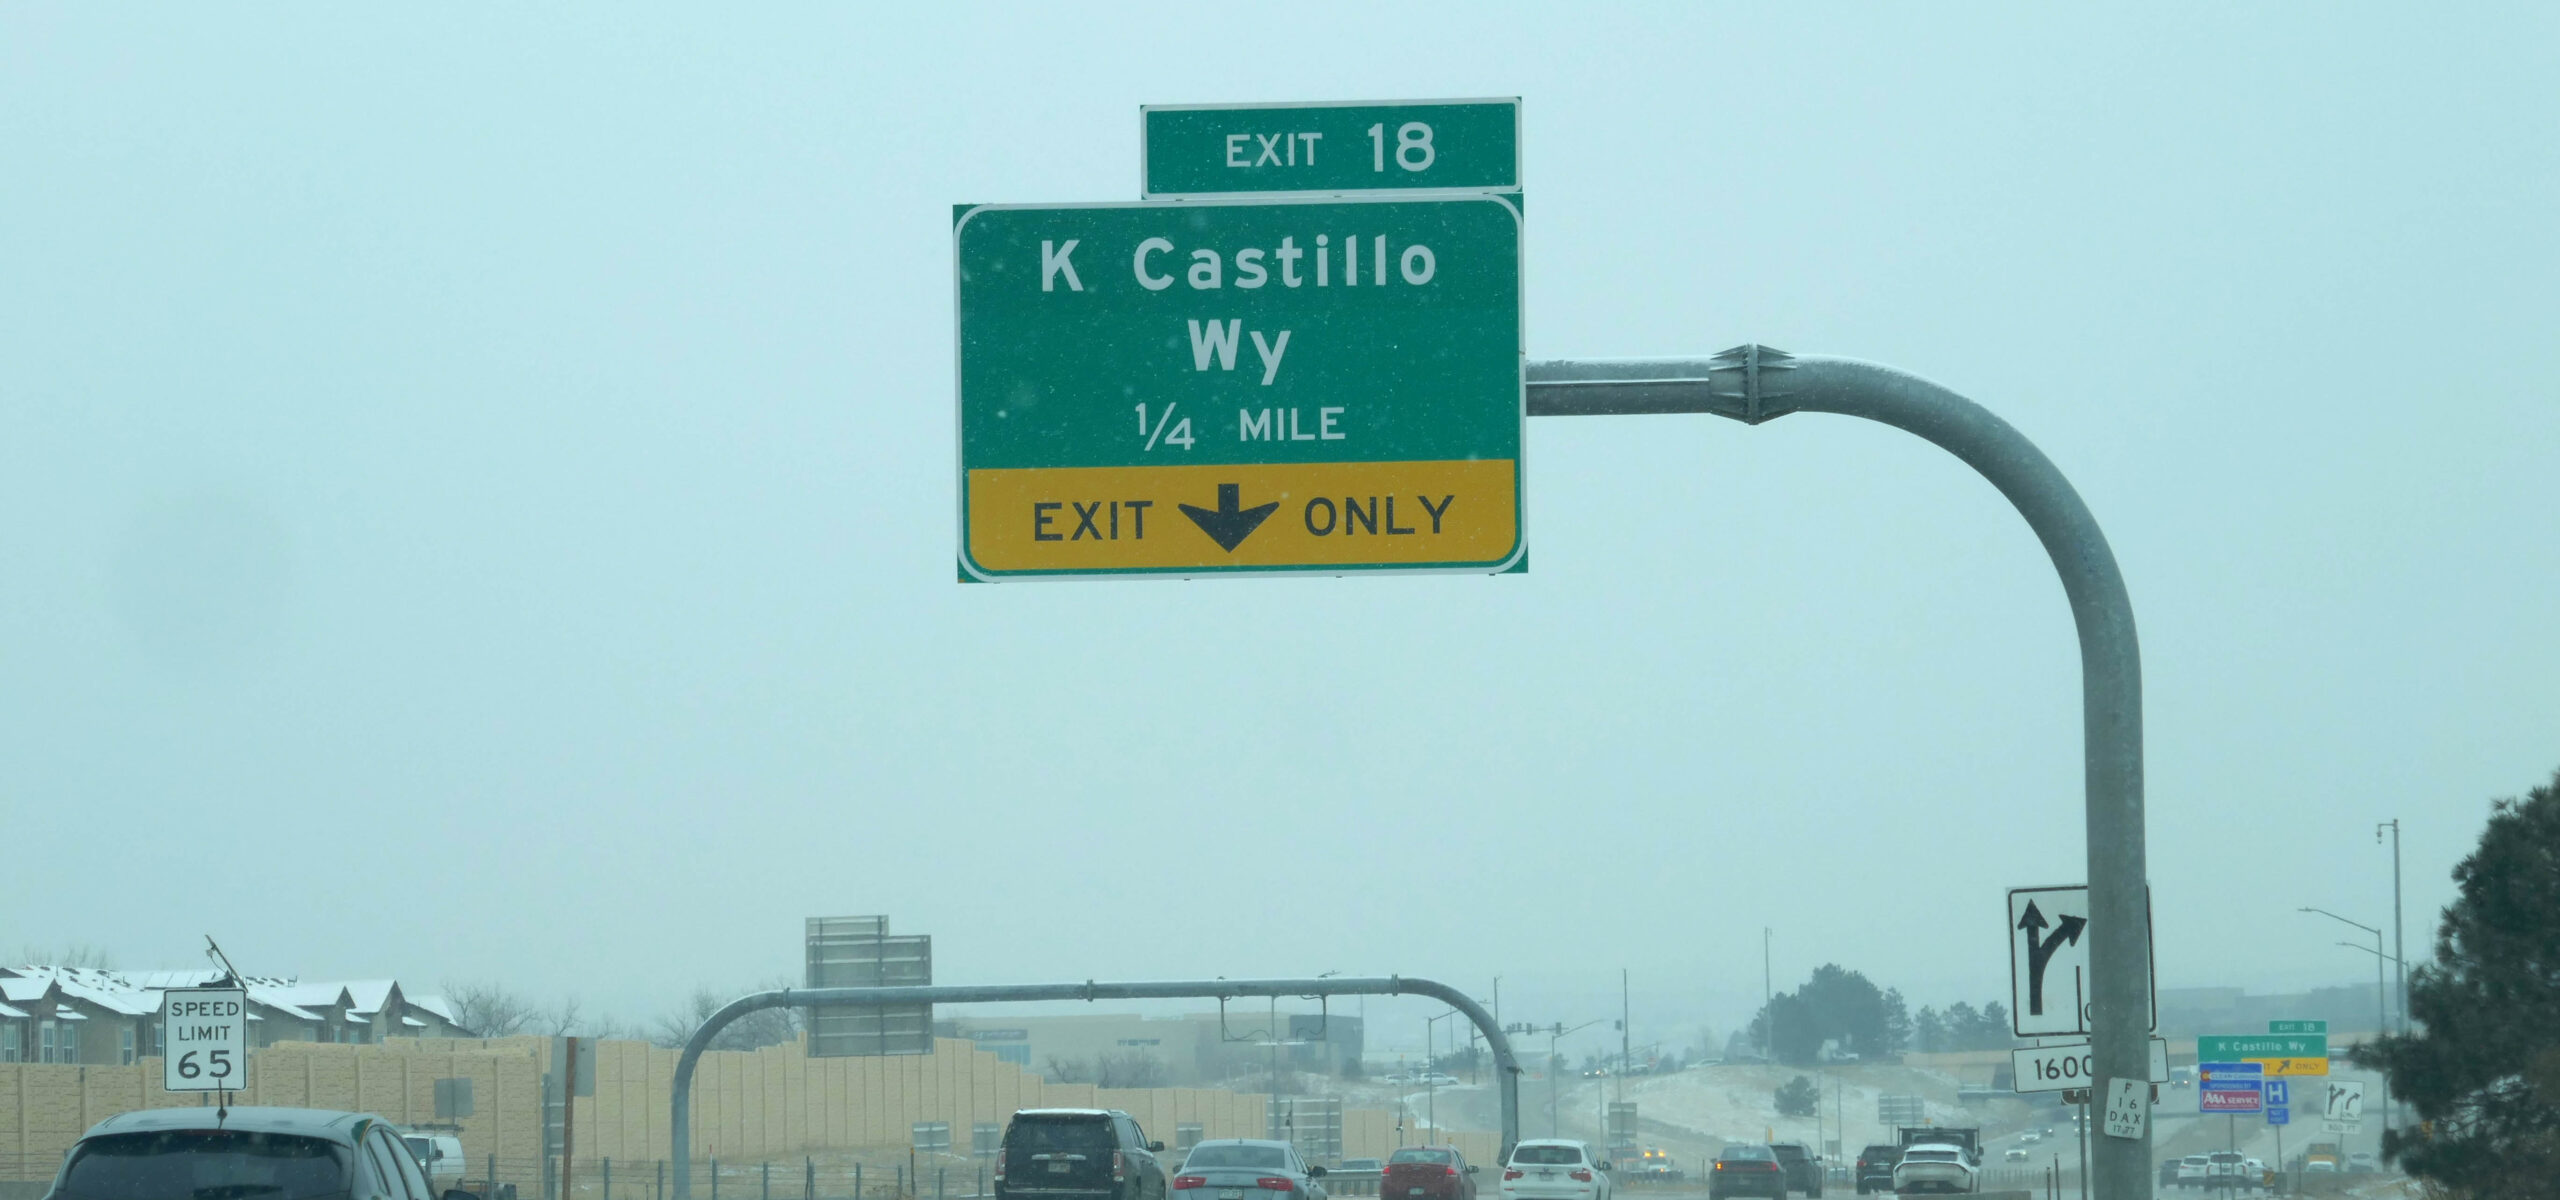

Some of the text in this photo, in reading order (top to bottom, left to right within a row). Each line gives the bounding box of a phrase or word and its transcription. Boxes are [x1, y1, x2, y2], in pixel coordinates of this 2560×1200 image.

[1226, 122, 1435, 172] EXIT 18
[1041, 234, 1437, 292] K Castillo
[1187, 319, 1291, 386] Wy
[1239, 407, 1345, 441] MILE
[1033, 494, 1455, 541] EXIT ONLY
[171, 1002, 239, 1016] SPEED
[179, 1026, 230, 1041] LIMIT
[2279, 1023, 2315, 1032] EXIT 18
[2218, 1041, 2306, 1052] K Castillo Wy
[178, 1050, 231, 1079] 65
[2124, 1082, 2133, 1094] F
[2268, 1084, 2284, 1102] H
